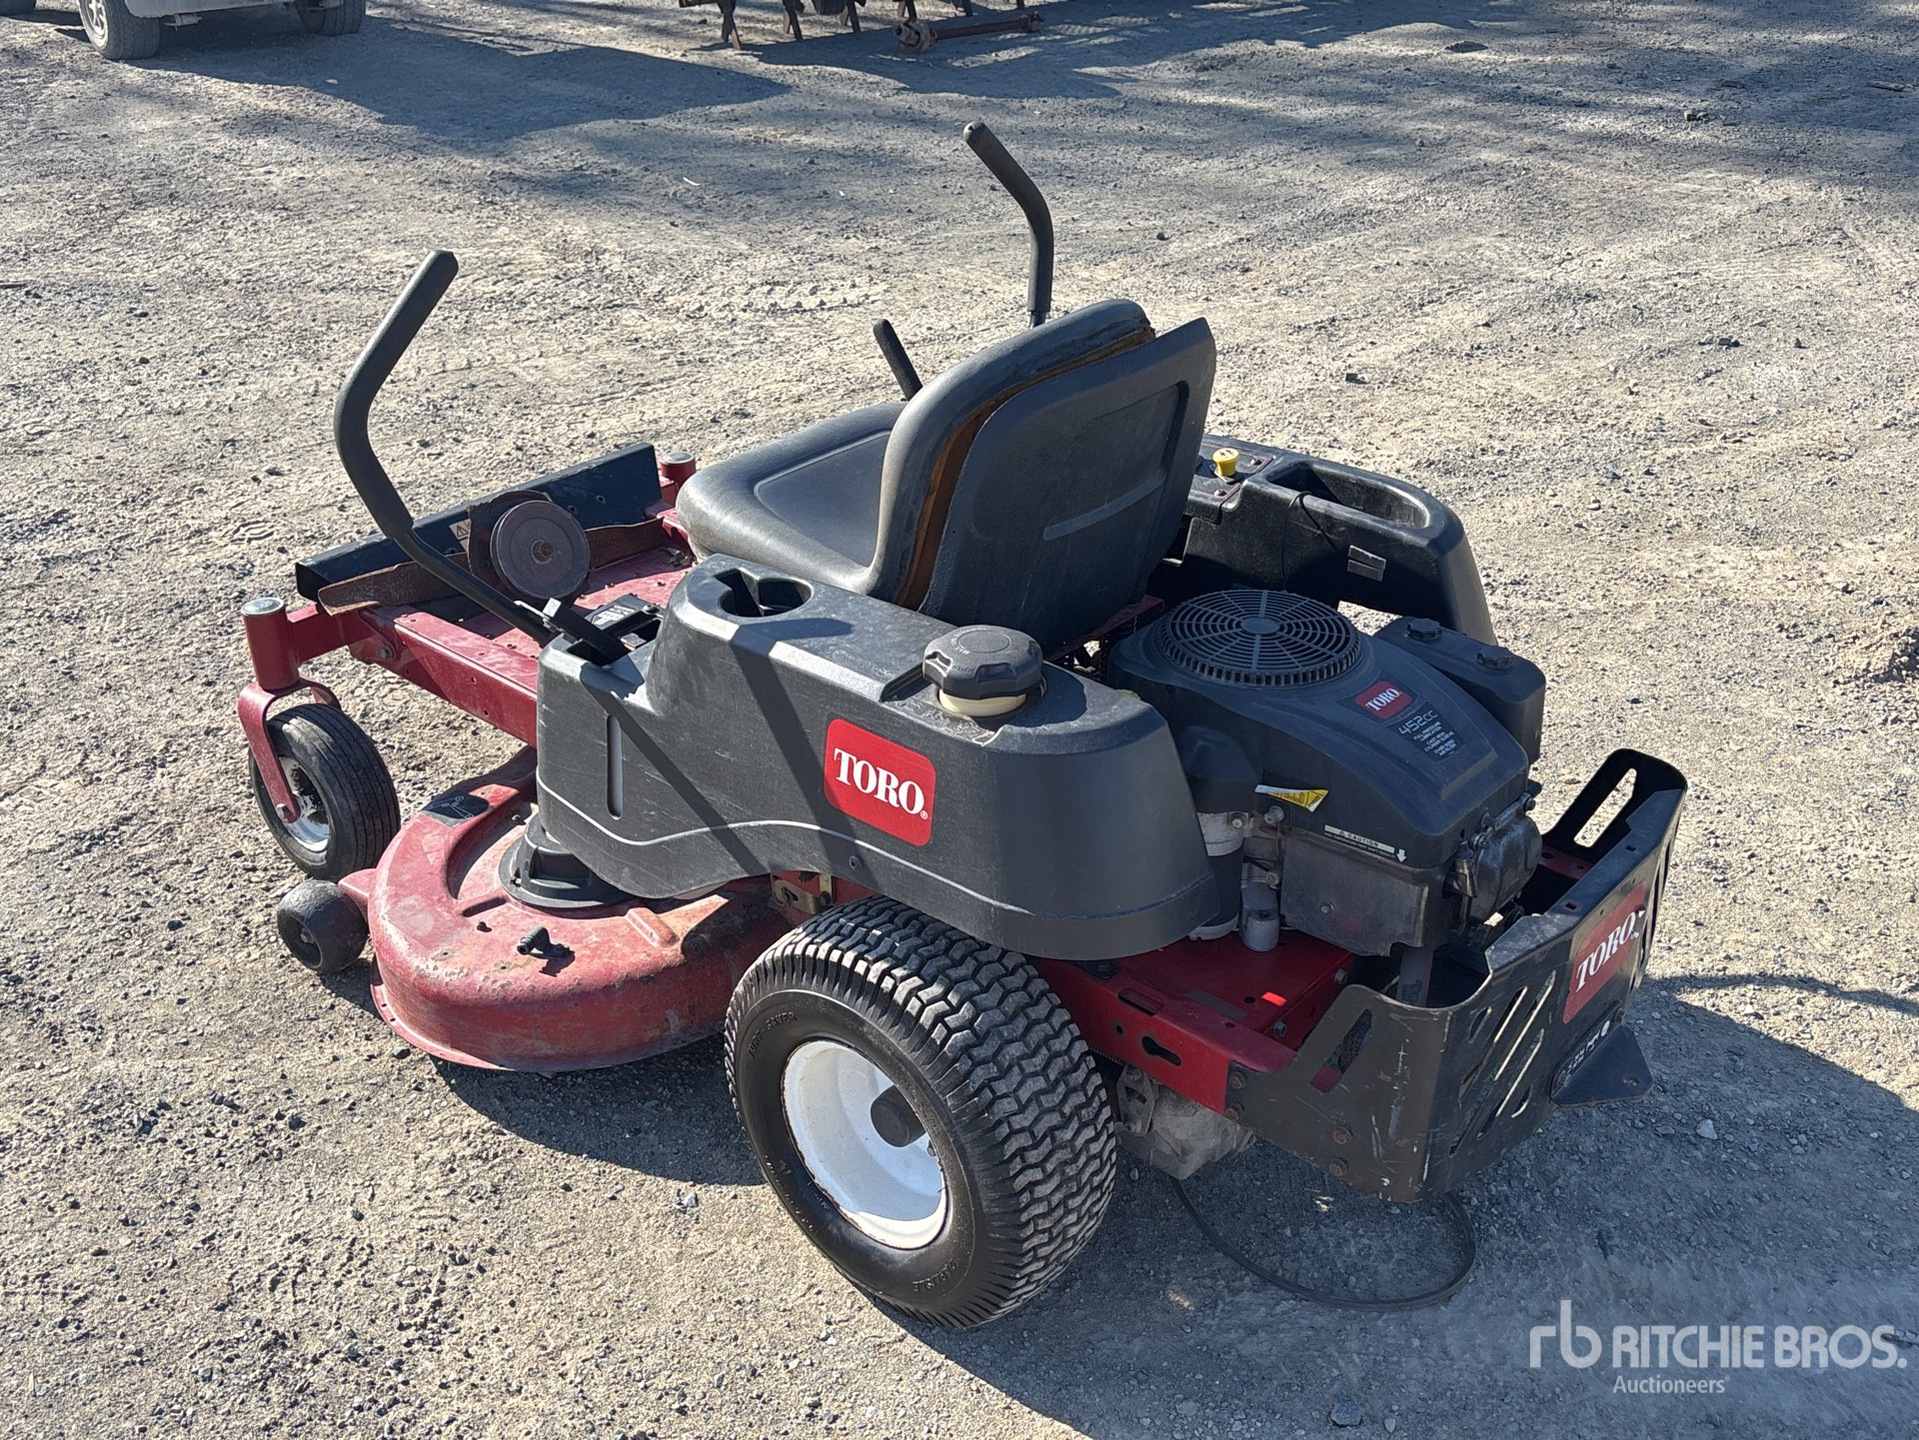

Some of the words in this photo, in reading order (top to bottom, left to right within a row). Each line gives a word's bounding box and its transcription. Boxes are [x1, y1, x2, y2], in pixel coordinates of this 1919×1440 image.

[1365, 687, 1400, 711] TORO
[833, 747, 925, 815] TORO
[1347, 833, 1379, 848] CAUTION
[1575, 911, 1636, 993] TORO
